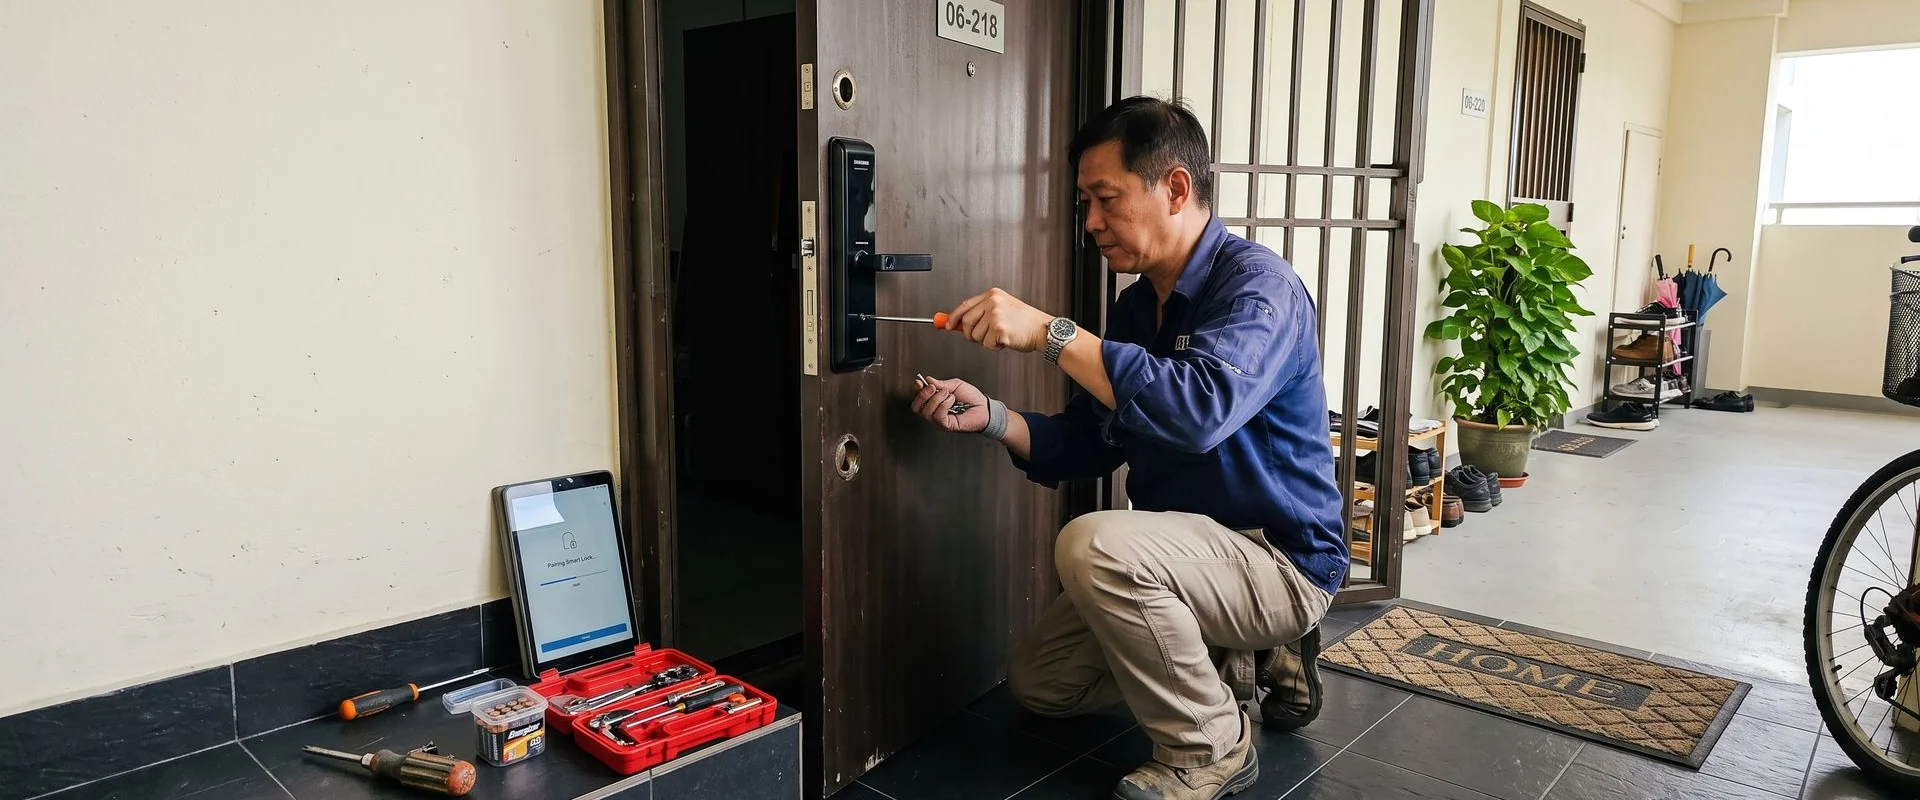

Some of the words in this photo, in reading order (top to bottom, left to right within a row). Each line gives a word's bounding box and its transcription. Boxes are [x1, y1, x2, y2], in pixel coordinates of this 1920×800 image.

[946, 1, 998, 38] 06-218
[565, 557, 581, 565] Smart
[1425, 641, 1624, 702] HOME
